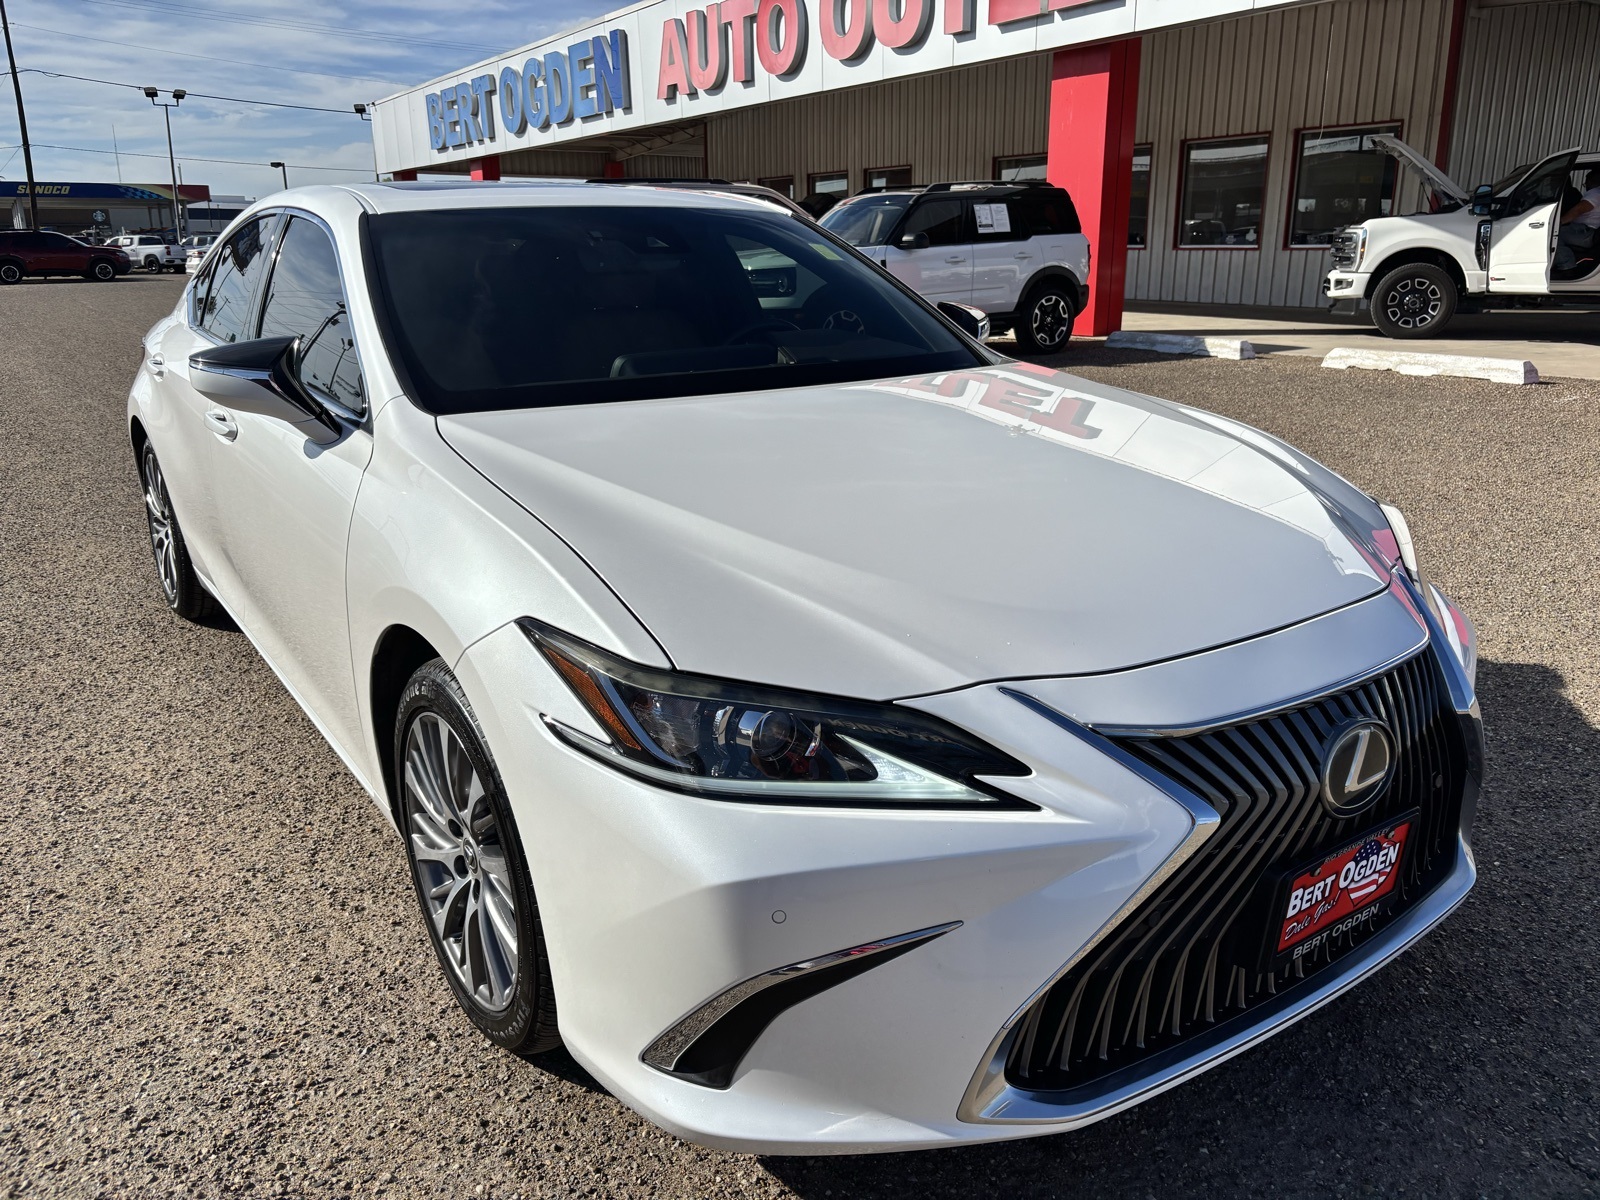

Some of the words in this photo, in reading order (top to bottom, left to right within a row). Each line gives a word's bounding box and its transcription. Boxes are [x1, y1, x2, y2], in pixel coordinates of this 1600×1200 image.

[426, 74, 496, 150] BERT
[499, 29, 631, 134] OGDEN
[657, 0, 808, 100] AUTO
[1286, 874, 1336, 919] BERT
[1339, 843, 1400, 889] OGDEN
[1284, 915, 1311, 940] Dale
[1293, 930, 1330, 960] BERT
[1332, 903, 1380, 937] OGDEN
